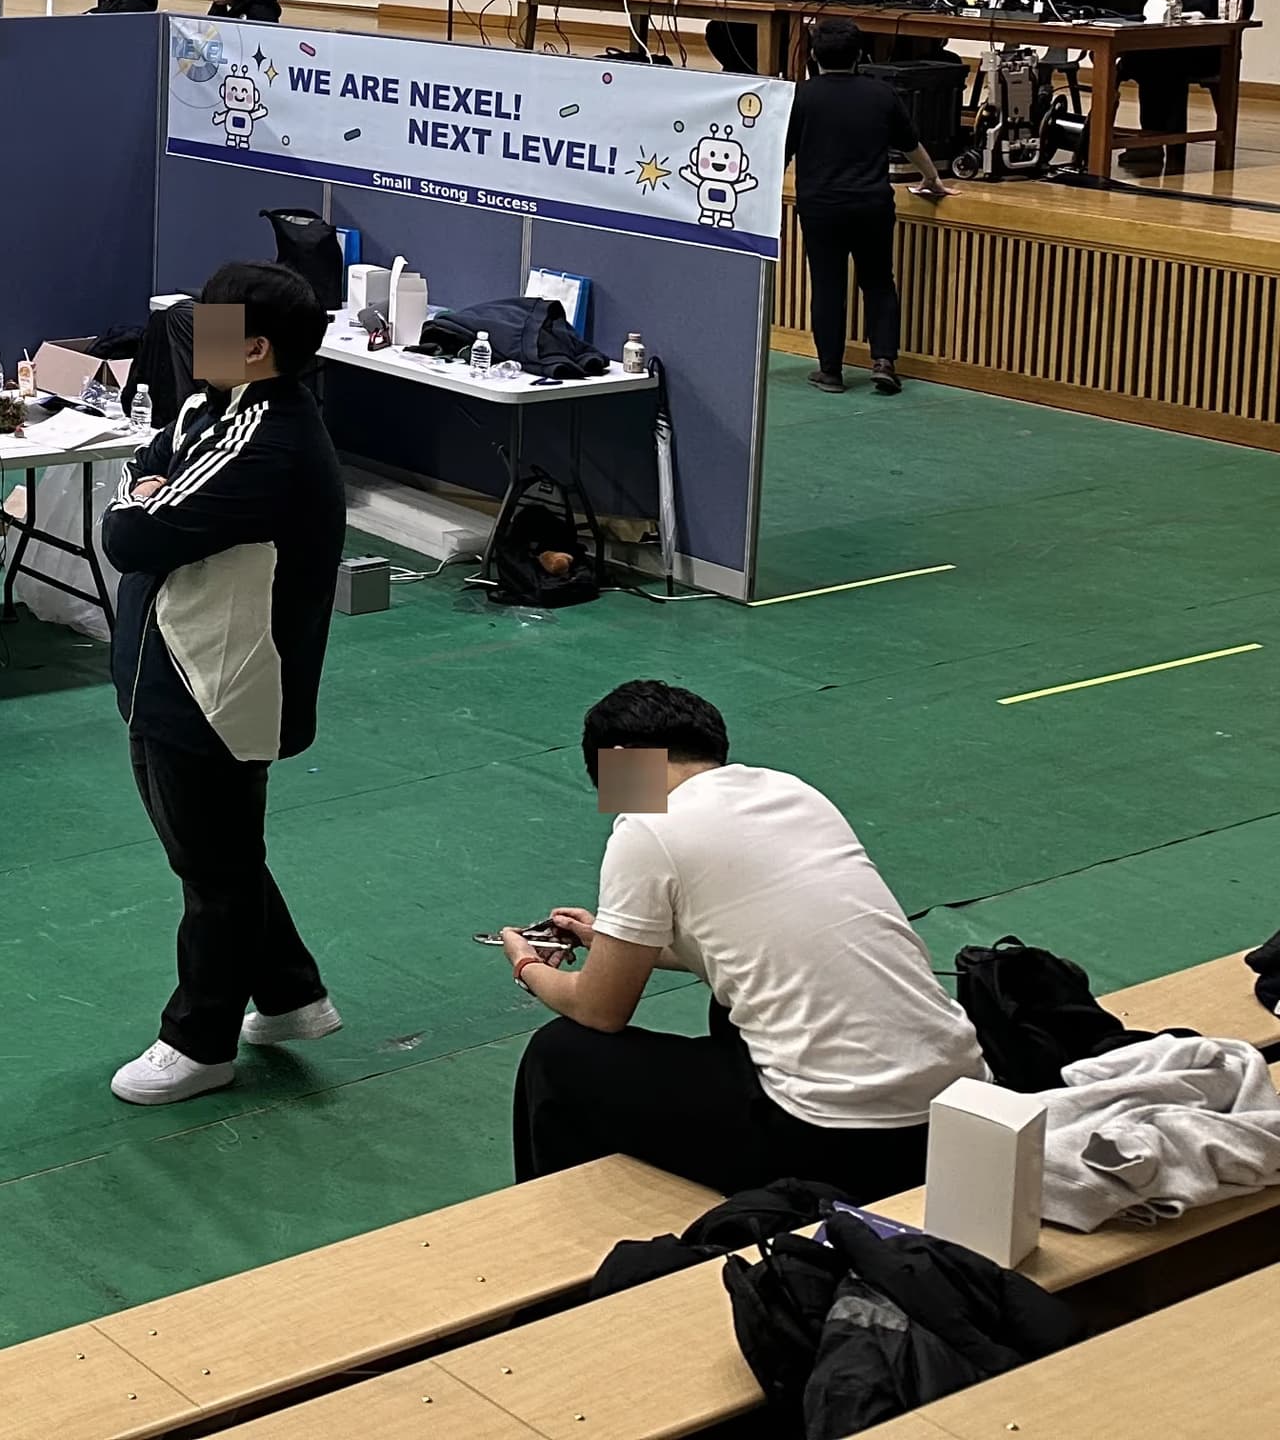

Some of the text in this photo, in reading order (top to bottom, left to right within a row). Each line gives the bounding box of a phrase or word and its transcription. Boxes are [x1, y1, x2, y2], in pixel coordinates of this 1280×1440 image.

[288, 66, 522, 121] WE ARE NEXEL!
[407, 118, 617, 175] NEXT LEVEL!
[372, 172, 538, 213] Small Strong Success
